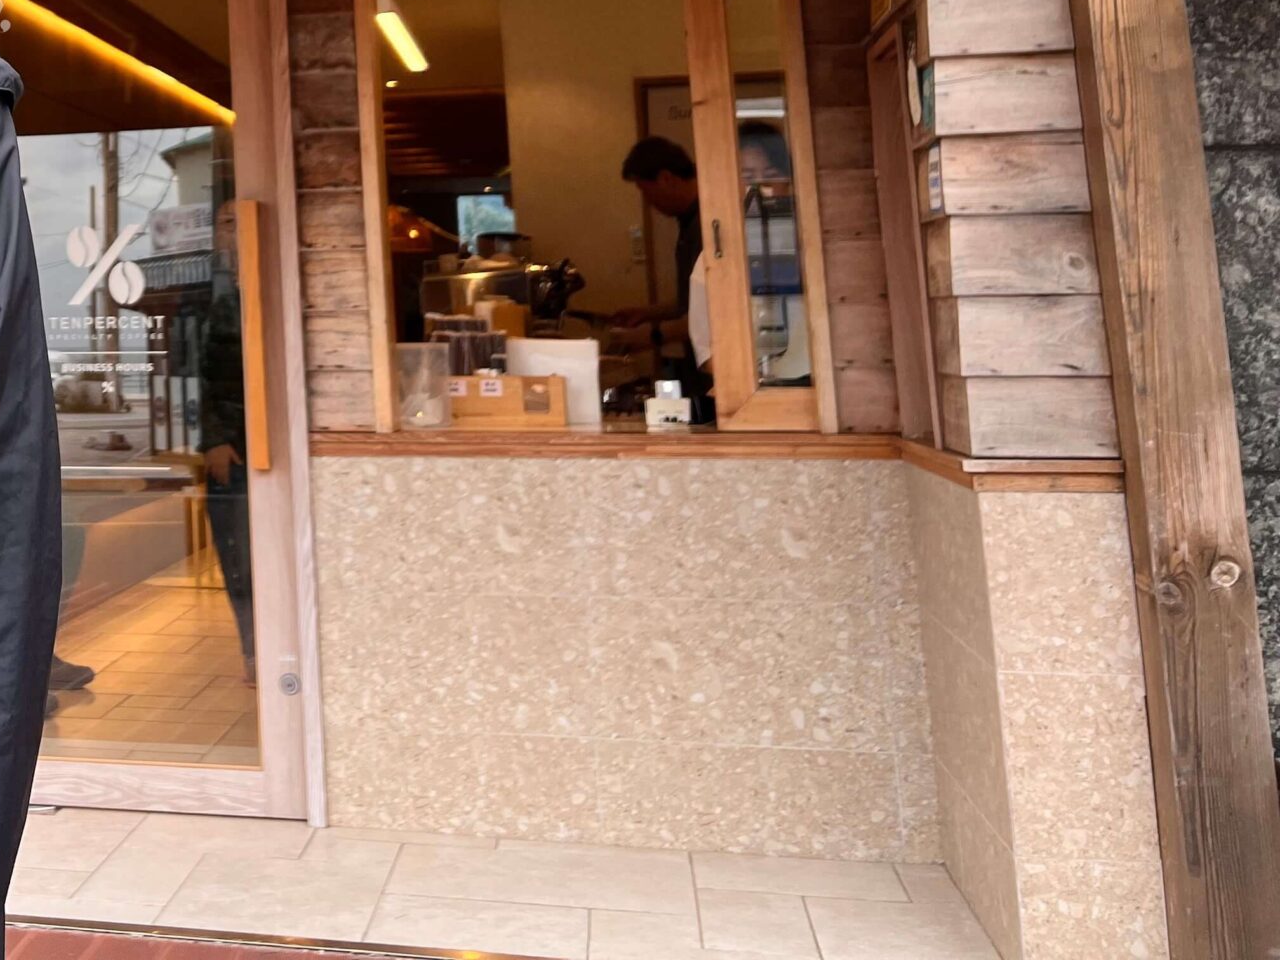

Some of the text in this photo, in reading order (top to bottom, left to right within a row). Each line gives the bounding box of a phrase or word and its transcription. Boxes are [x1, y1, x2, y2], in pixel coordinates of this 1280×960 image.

[48, 316, 165, 329] TENPERCENT
[61, 363, 155, 372] BUSINESS HOURS
